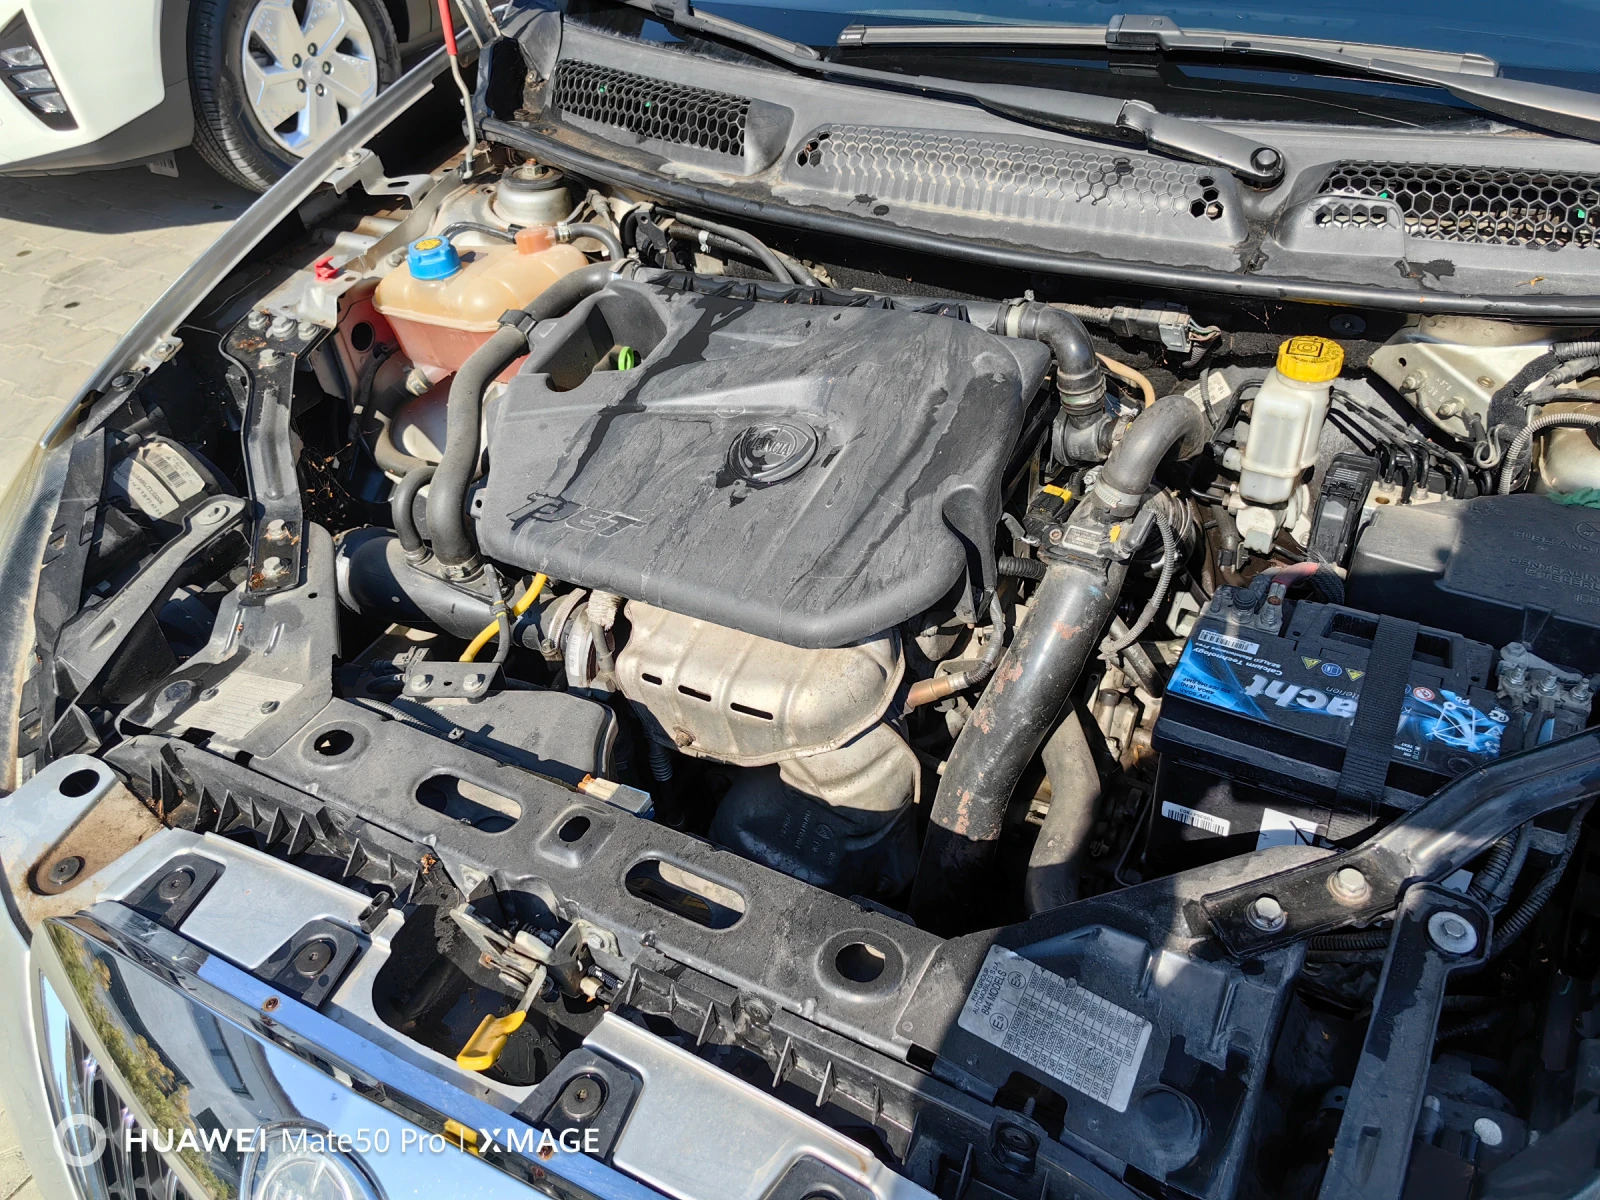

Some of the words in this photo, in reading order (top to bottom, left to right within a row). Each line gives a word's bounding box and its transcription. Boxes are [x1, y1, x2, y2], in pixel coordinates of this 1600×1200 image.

[752, 437, 791, 456] LANCIA
[1560, 541, 1592, 552] AND
[1192, 647, 1243, 666] Technology
[1253, 658, 1281, 669] SEALED
[1245, 662, 1283, 676] Calcium
[1244, 674, 1359, 719] acht
[1455, 696, 1470, 705] Pb
[971, 989, 979, 1000] FIAT
[977, 967, 989, 987] GROUP
[972, 975, 992, 1013] AUTOMOBILES
[981, 1001, 992, 1014] 844
[987, 970, 1006, 1000] MODELS
[1003, 1033, 1014, 1049] 13HR
[1011, 1010, 1024, 1031] 002916
[1012, 1038, 1022, 1054] 13HR
[1019, 1015, 1032, 1036] 002917
[1020, 1043, 1031, 1058] 13HR
[1028, 1019, 1040, 1040] 002918
[1030, 1049, 1039, 1061] 24R
[1036, 1023, 1049, 1045] 032919
[1047, 1058, 1056, 1070] 24R
[1054, 1033, 1066, 1054] 032921
[1039, 1054, 1047, 1066] 24R
[1056, 1063, 1065, 1075] 51R
[1062, 1037, 1075, 1059] 022922
[1065, 1067, 1074, 1080] 51R
[1074, 1072, 1082, 1085] 51R
[1106, 1060, 1118, 1083] 002927
[1082, 1077, 1091, 1090] 51R
[1092, 1082, 1100, 1094] 51R
